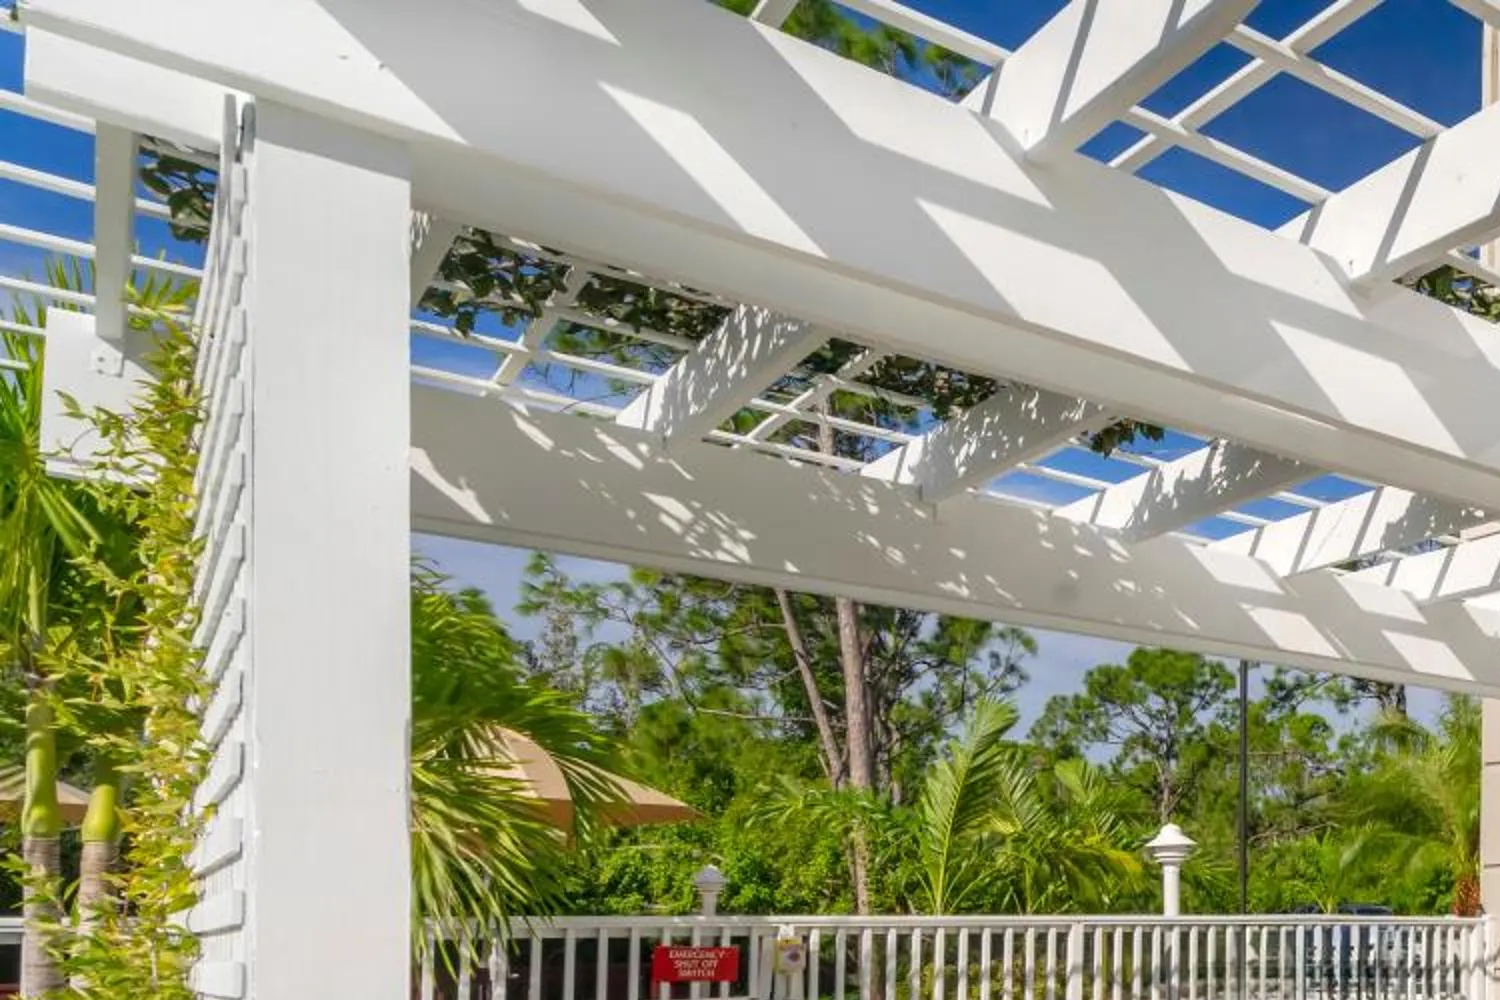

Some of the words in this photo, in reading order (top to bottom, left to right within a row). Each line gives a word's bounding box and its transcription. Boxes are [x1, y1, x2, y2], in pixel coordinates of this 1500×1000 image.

[669, 949, 725, 959] EMERGENCY
[674, 959, 699, 969] SHUT
[701, 959, 719, 969] OFF
[677, 969, 715, 977] SWITCH
